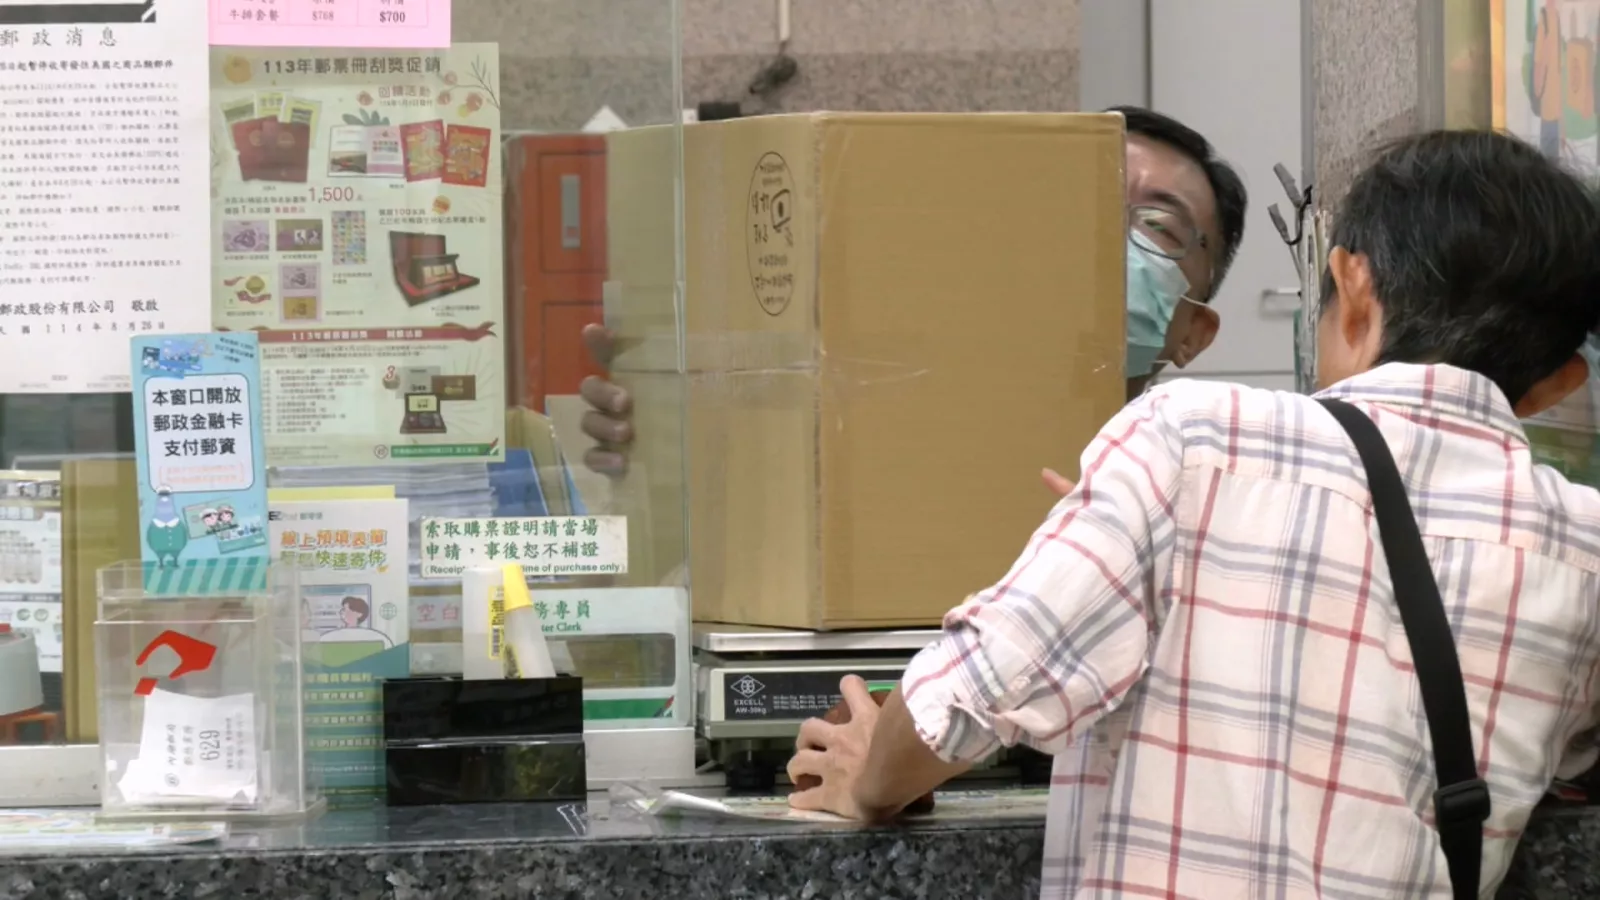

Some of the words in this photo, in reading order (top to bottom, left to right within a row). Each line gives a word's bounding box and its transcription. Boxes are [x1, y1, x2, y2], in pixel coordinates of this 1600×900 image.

[379, 11, 406, 23] $700
[308, 187, 354, 204] 1,500
[152, 387, 242, 406] 本窗口開放
[153, 412, 243, 432] 郵政金融卡
[164, 437, 236, 457] 支付郵資
[425, 518, 599, 538] 索取購票證明請當場
[542, 563, 551, 572] of
[553, 563, 598, 574] purchase
[556, 621, 582, 632] Clerk
[199, 729, 221, 761] 629
